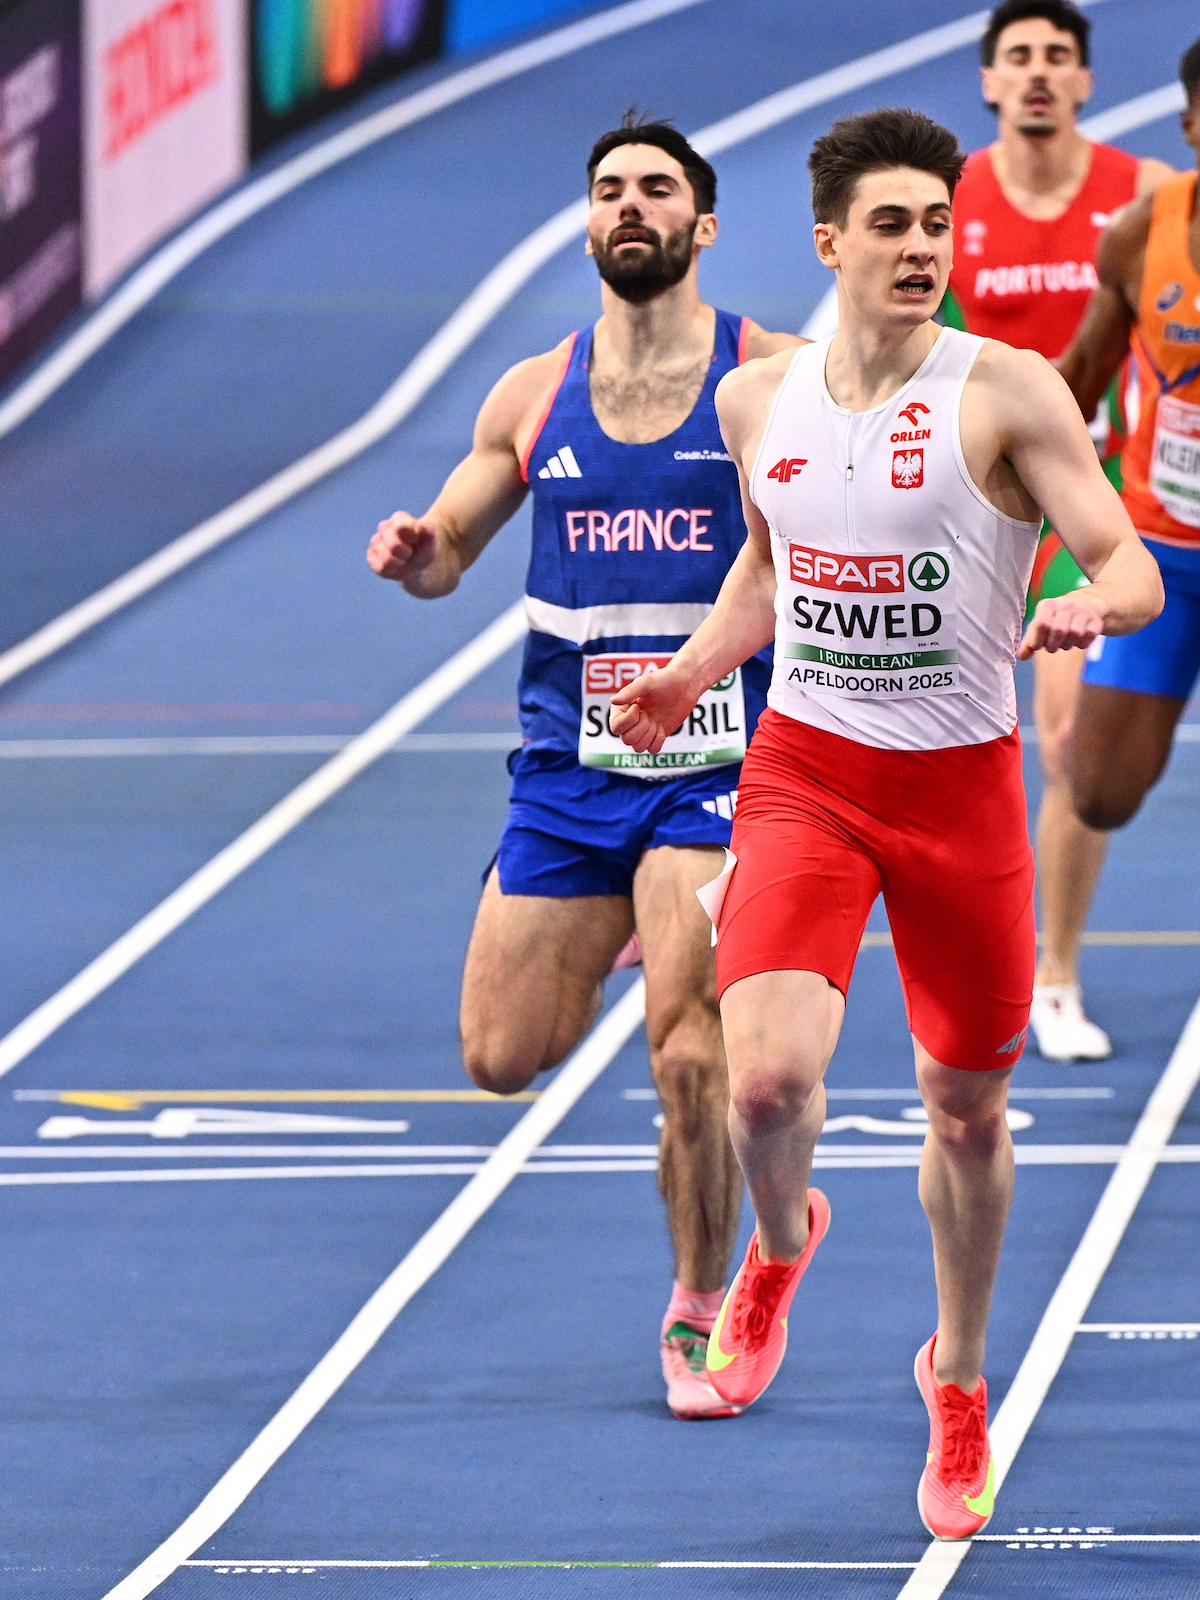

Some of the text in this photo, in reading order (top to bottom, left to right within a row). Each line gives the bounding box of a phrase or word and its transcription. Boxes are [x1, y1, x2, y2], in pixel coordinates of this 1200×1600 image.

[974, 261, 1100, 298] PORTUGA
[890, 428, 932, 443] ORLEN
[767, 458, 808, 483] 4F
[565, 509, 715, 553] FRANCE
[791, 550, 901, 588] SPAR
[793, 595, 942, 639] SZWED
[819, 649, 823, 661] I
[826, 651, 856, 667] RUN
[588, 661, 662, 690] SP
[788, 667, 953, 692] APELDOORN 2025
[614, 755, 619, 767] I
[621, 755, 654, 767] RUN
